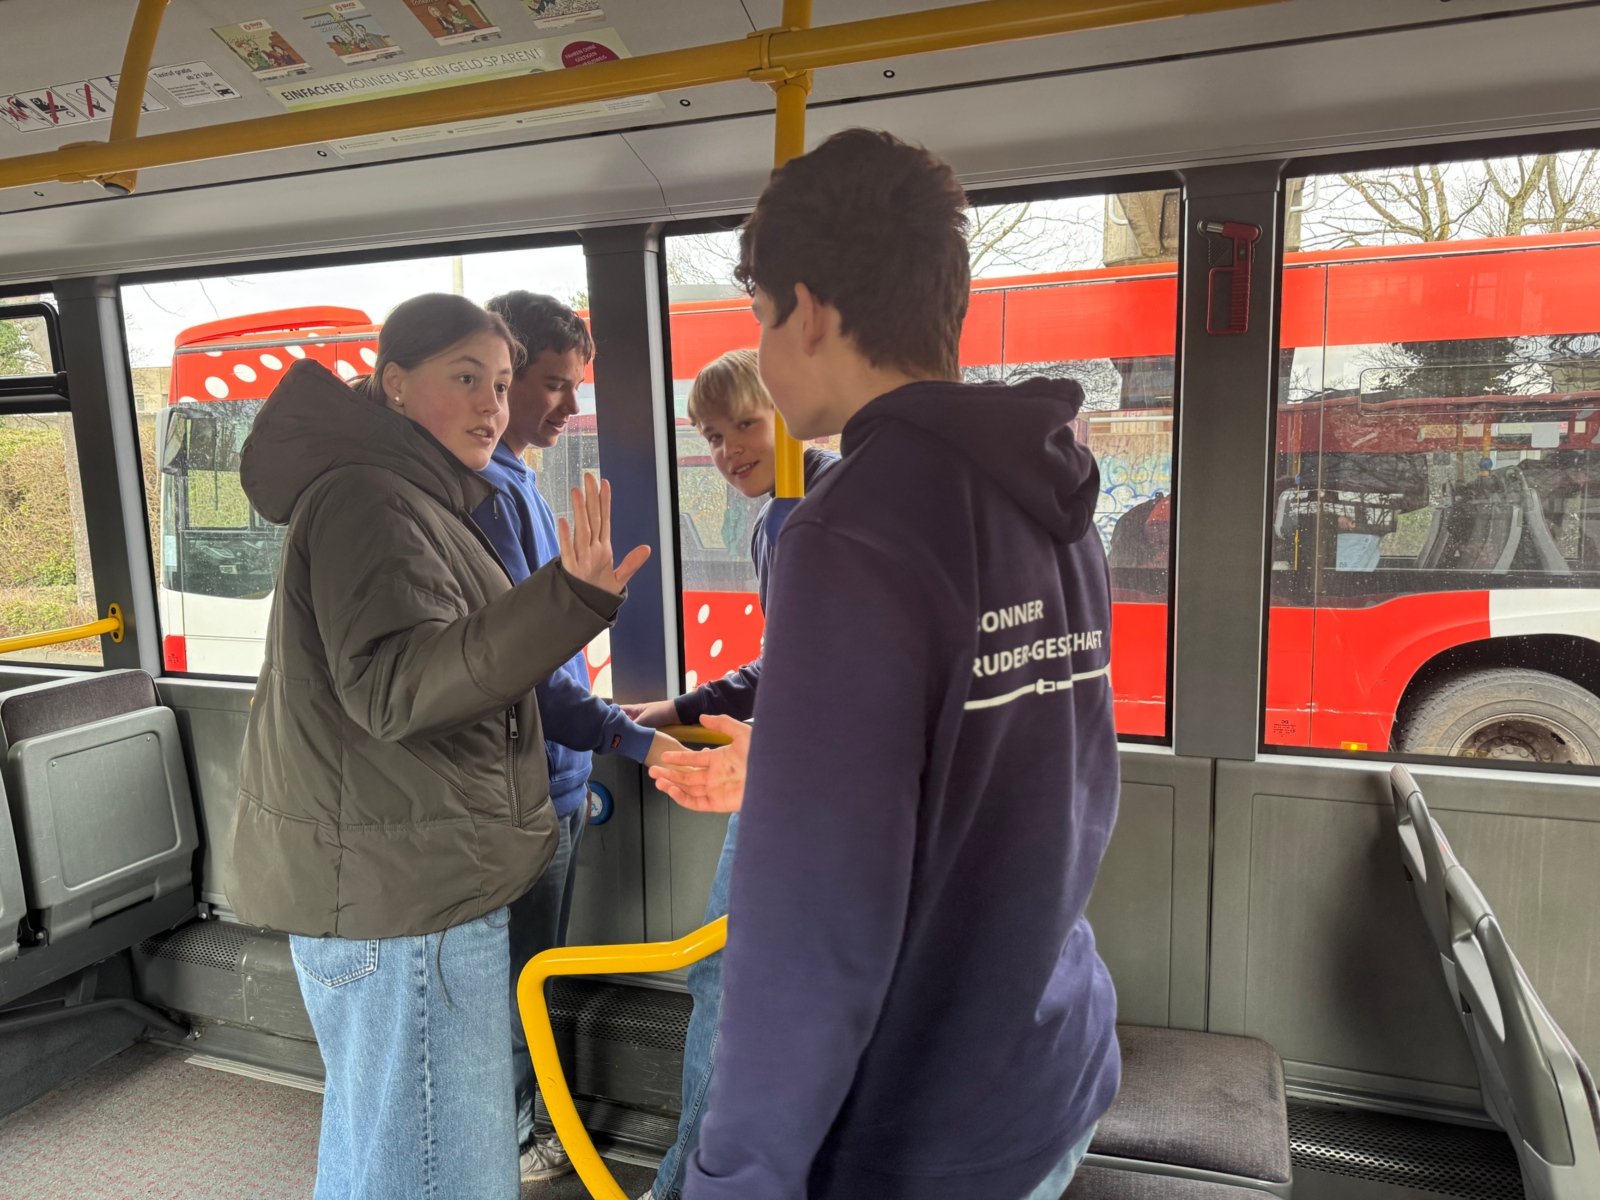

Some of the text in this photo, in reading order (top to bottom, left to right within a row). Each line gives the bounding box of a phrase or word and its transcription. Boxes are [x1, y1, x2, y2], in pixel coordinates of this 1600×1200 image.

[281, 82, 348, 101] EINFACHER
[346, 74, 399, 90] KÖNNEN
[398, 69, 418, 82] SIE
[420, 64, 448, 78] KEIN
[449, 59, 483, 73] GELD
[977, 600, 1045, 633] ONNER
